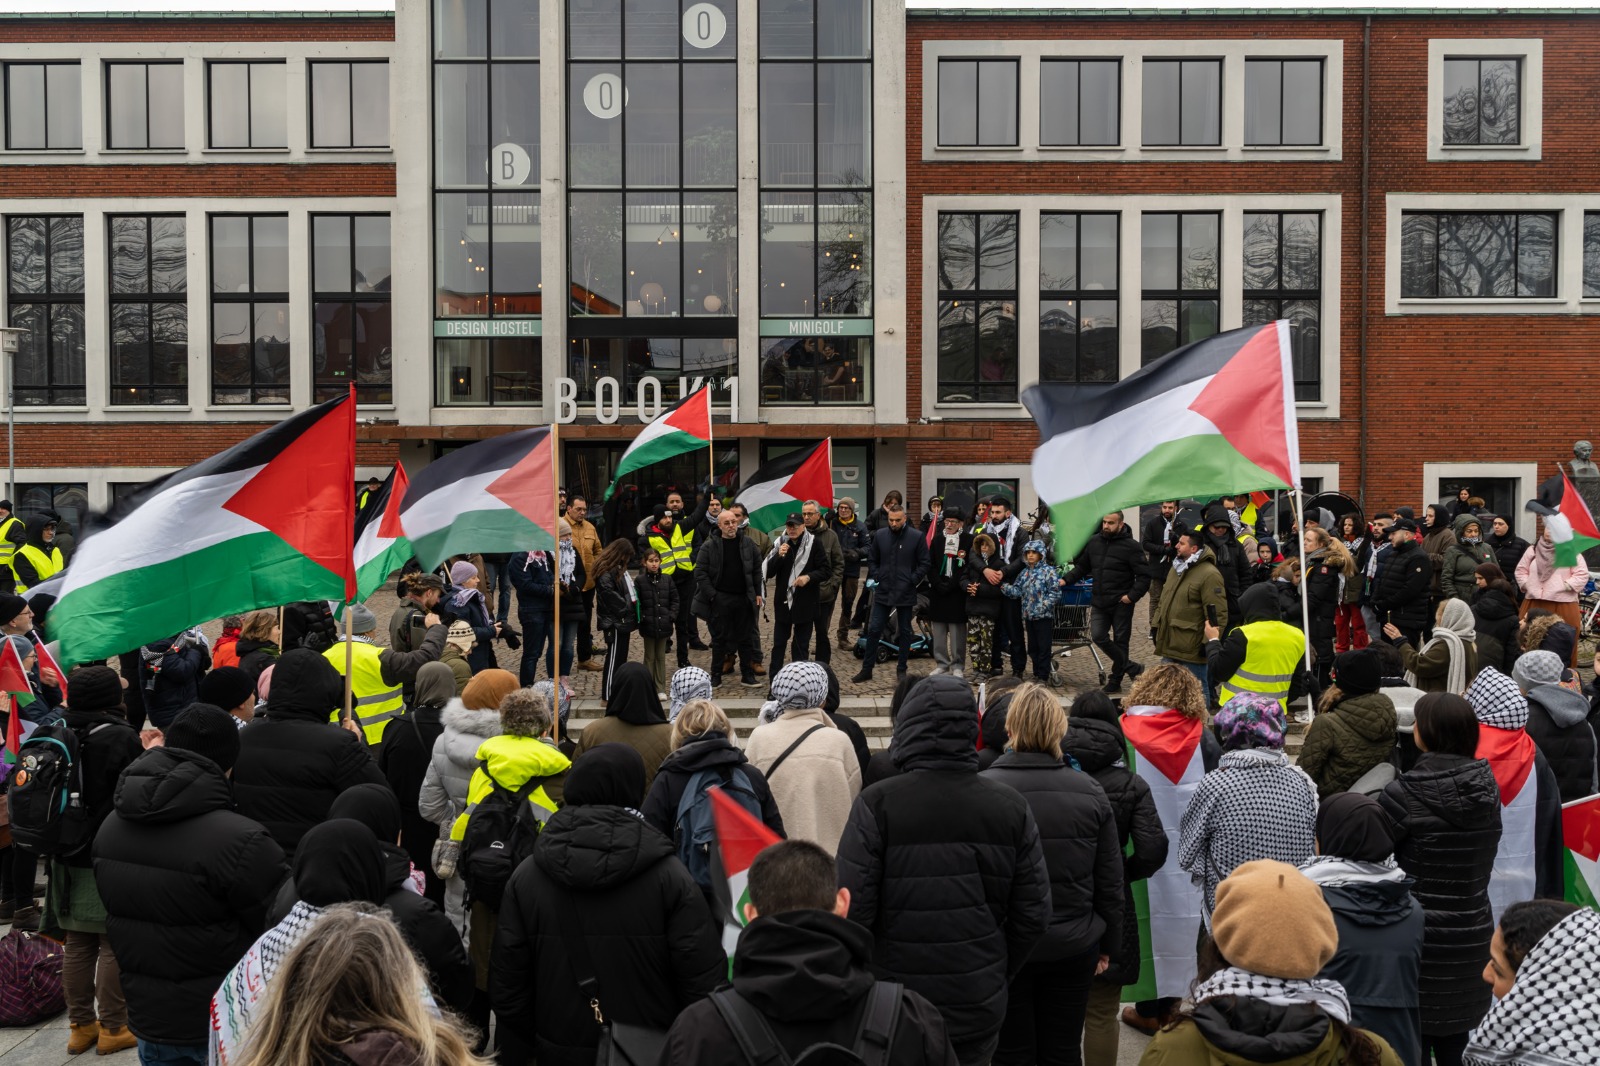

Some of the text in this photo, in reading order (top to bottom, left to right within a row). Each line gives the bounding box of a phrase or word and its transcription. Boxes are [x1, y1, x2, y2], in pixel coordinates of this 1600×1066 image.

[501, 151, 515, 180] B
[447, 321, 535, 335] DESIGN HOSTEL
[789, 321, 844, 334] MINIGOLF
